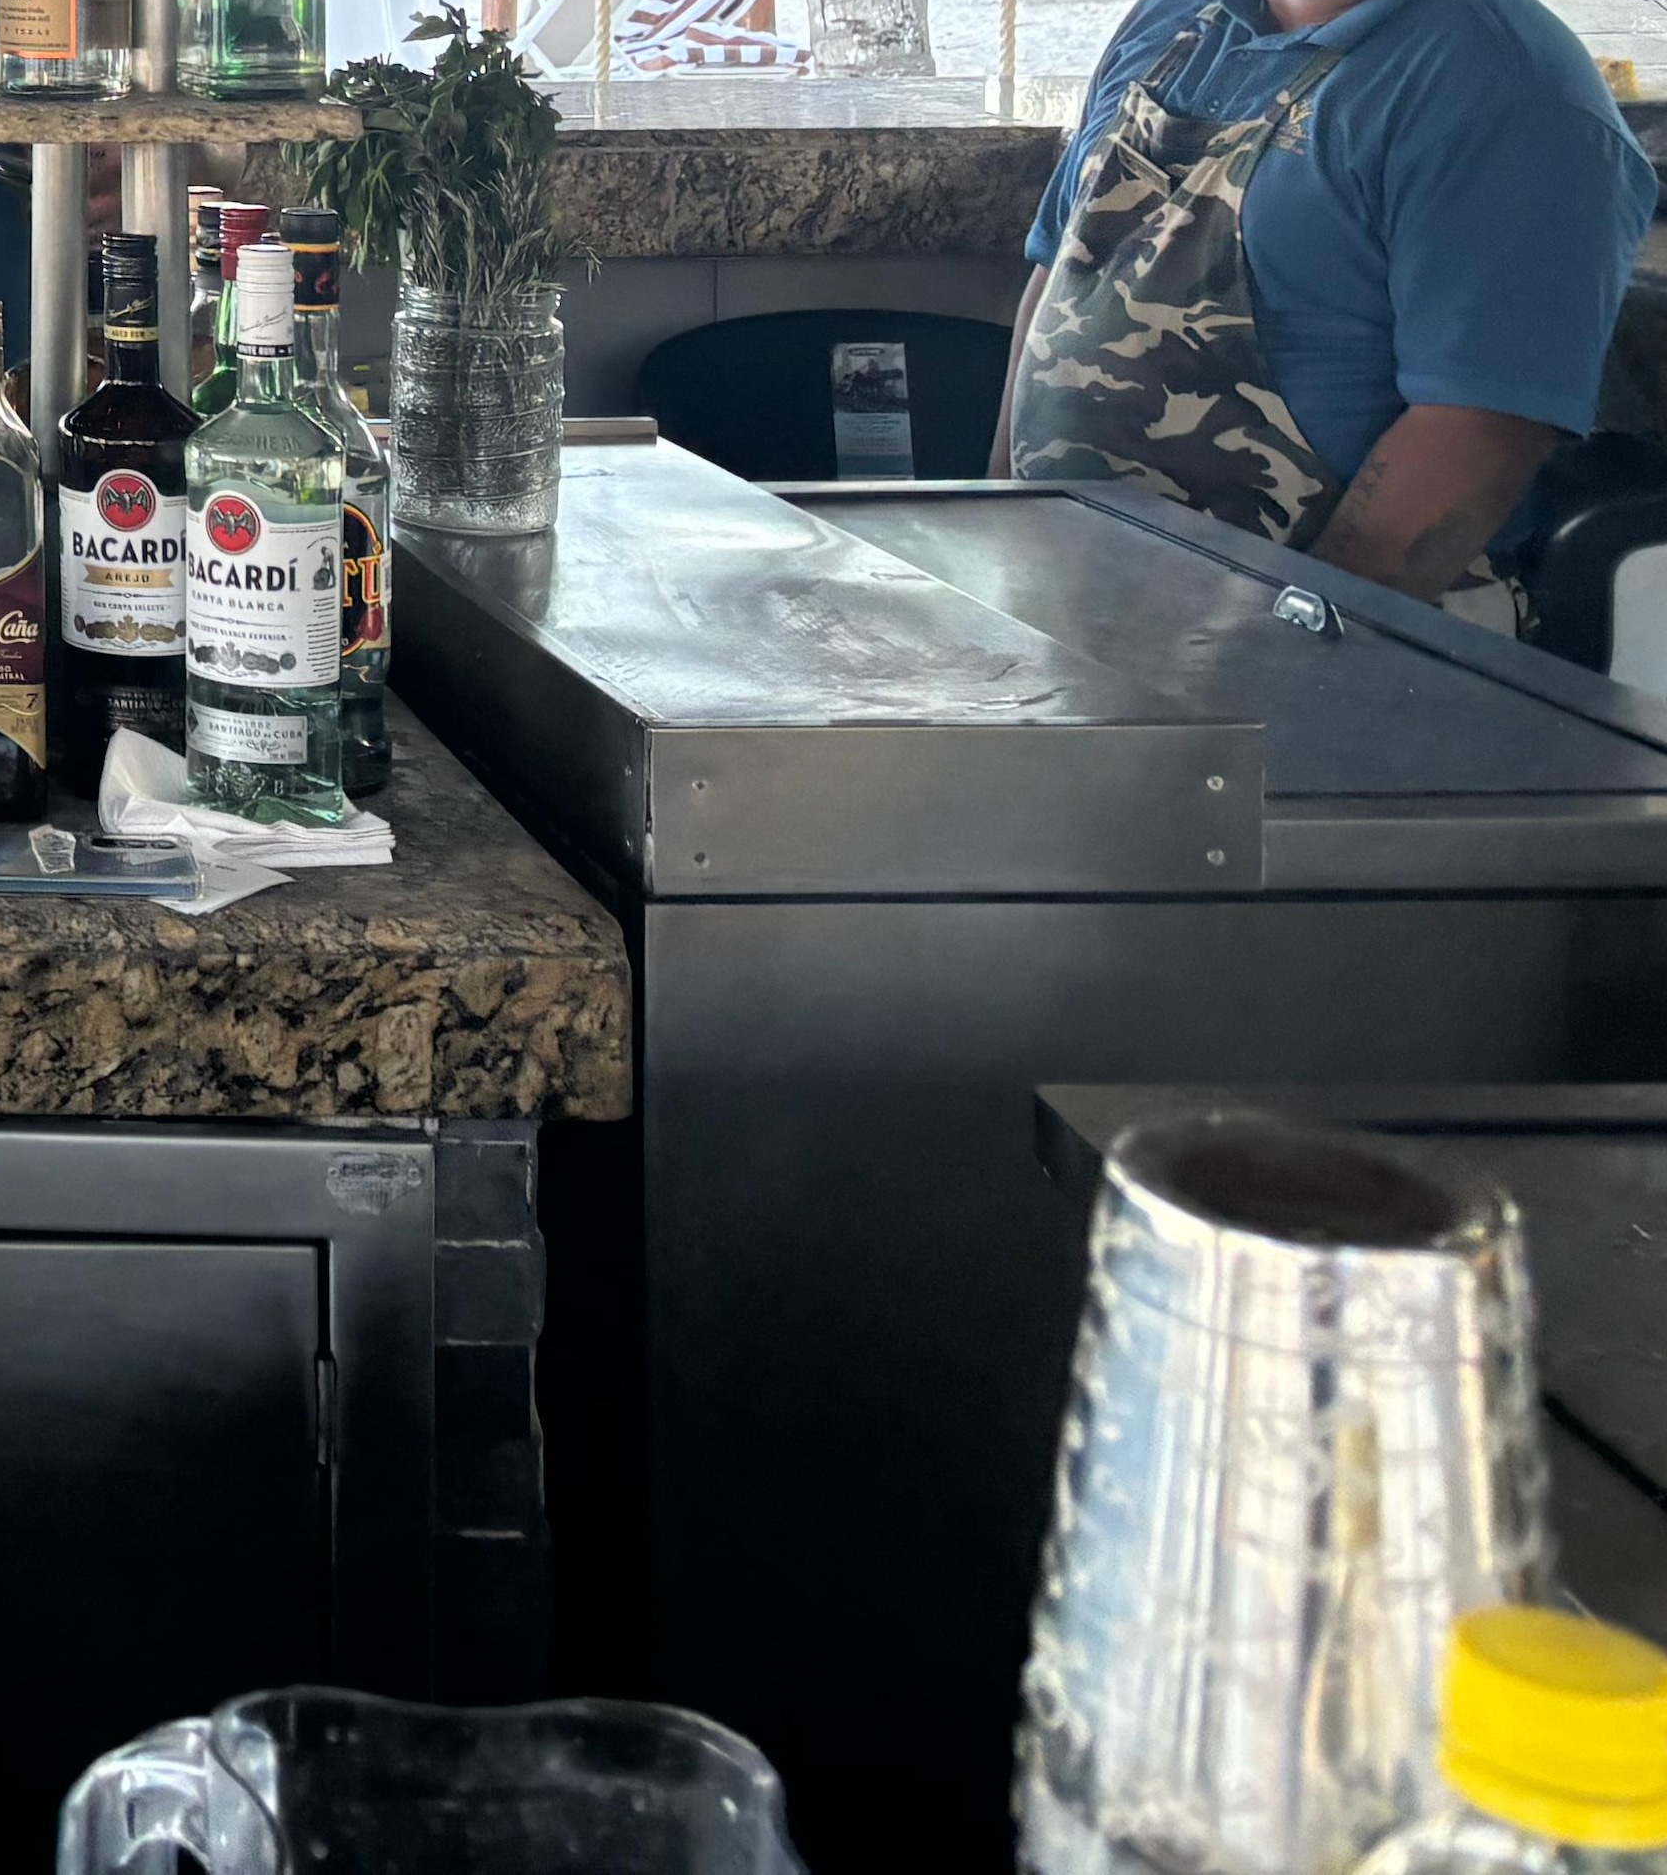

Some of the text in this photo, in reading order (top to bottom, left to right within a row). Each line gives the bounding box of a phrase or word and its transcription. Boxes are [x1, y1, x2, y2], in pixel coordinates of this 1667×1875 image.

[72, 529, 186, 564] BACARDÍ
[105, 570, 150, 584] AÑEJO
[188, 551, 298, 593] BACARDÍ
[228, 599, 285, 612] BLANCA
[25, 692, 39, 709] 7
[209, 721, 261, 738] SANTIAGO
[273, 730, 302, 739] CUBA
